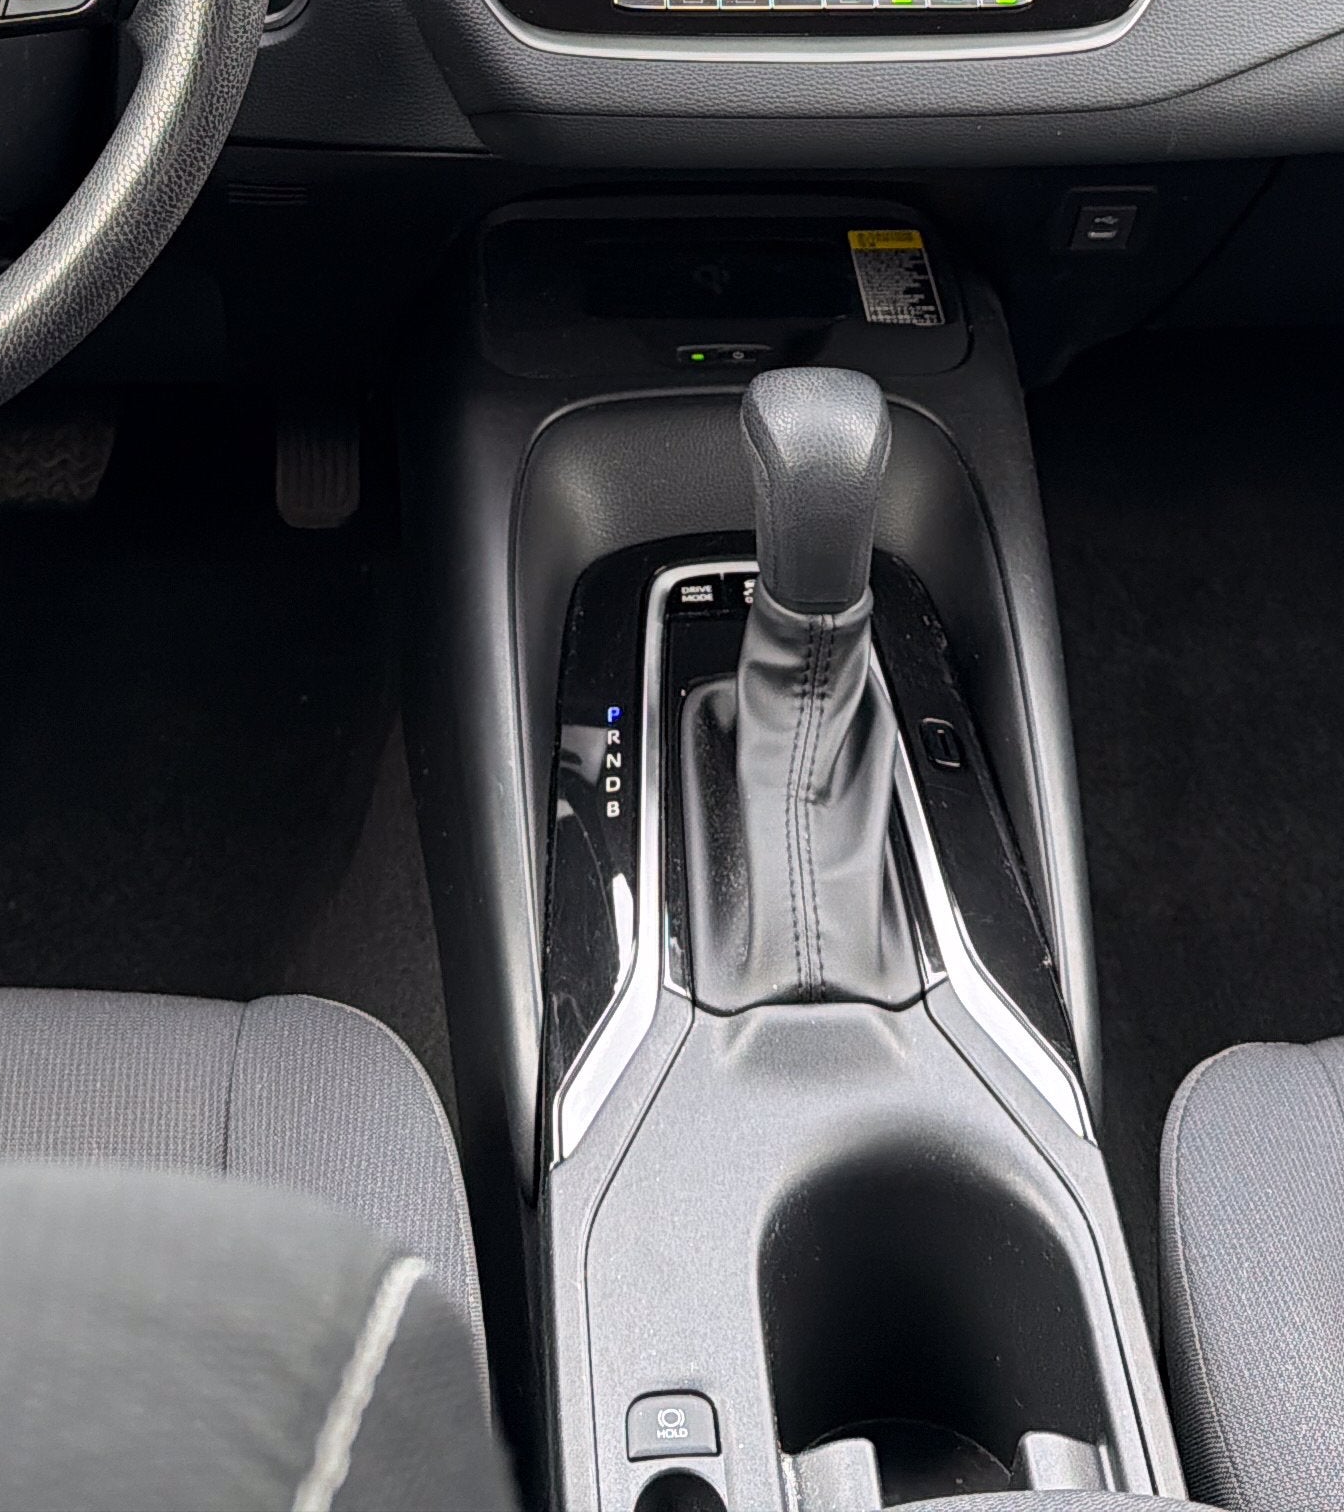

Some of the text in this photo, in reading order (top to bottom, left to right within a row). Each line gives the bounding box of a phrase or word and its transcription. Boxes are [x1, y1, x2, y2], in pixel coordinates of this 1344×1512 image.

[681, 585, 713, 595] DRIVE
[681, 593, 714, 603] MODE
[606, 706, 621, 723] P
[606, 730, 621, 745] R
[606, 753, 621, 768] N
[606, 777, 621, 793] D
[606, 801, 621, 818] B
[656, 1427, 689, 1439] HOLD
